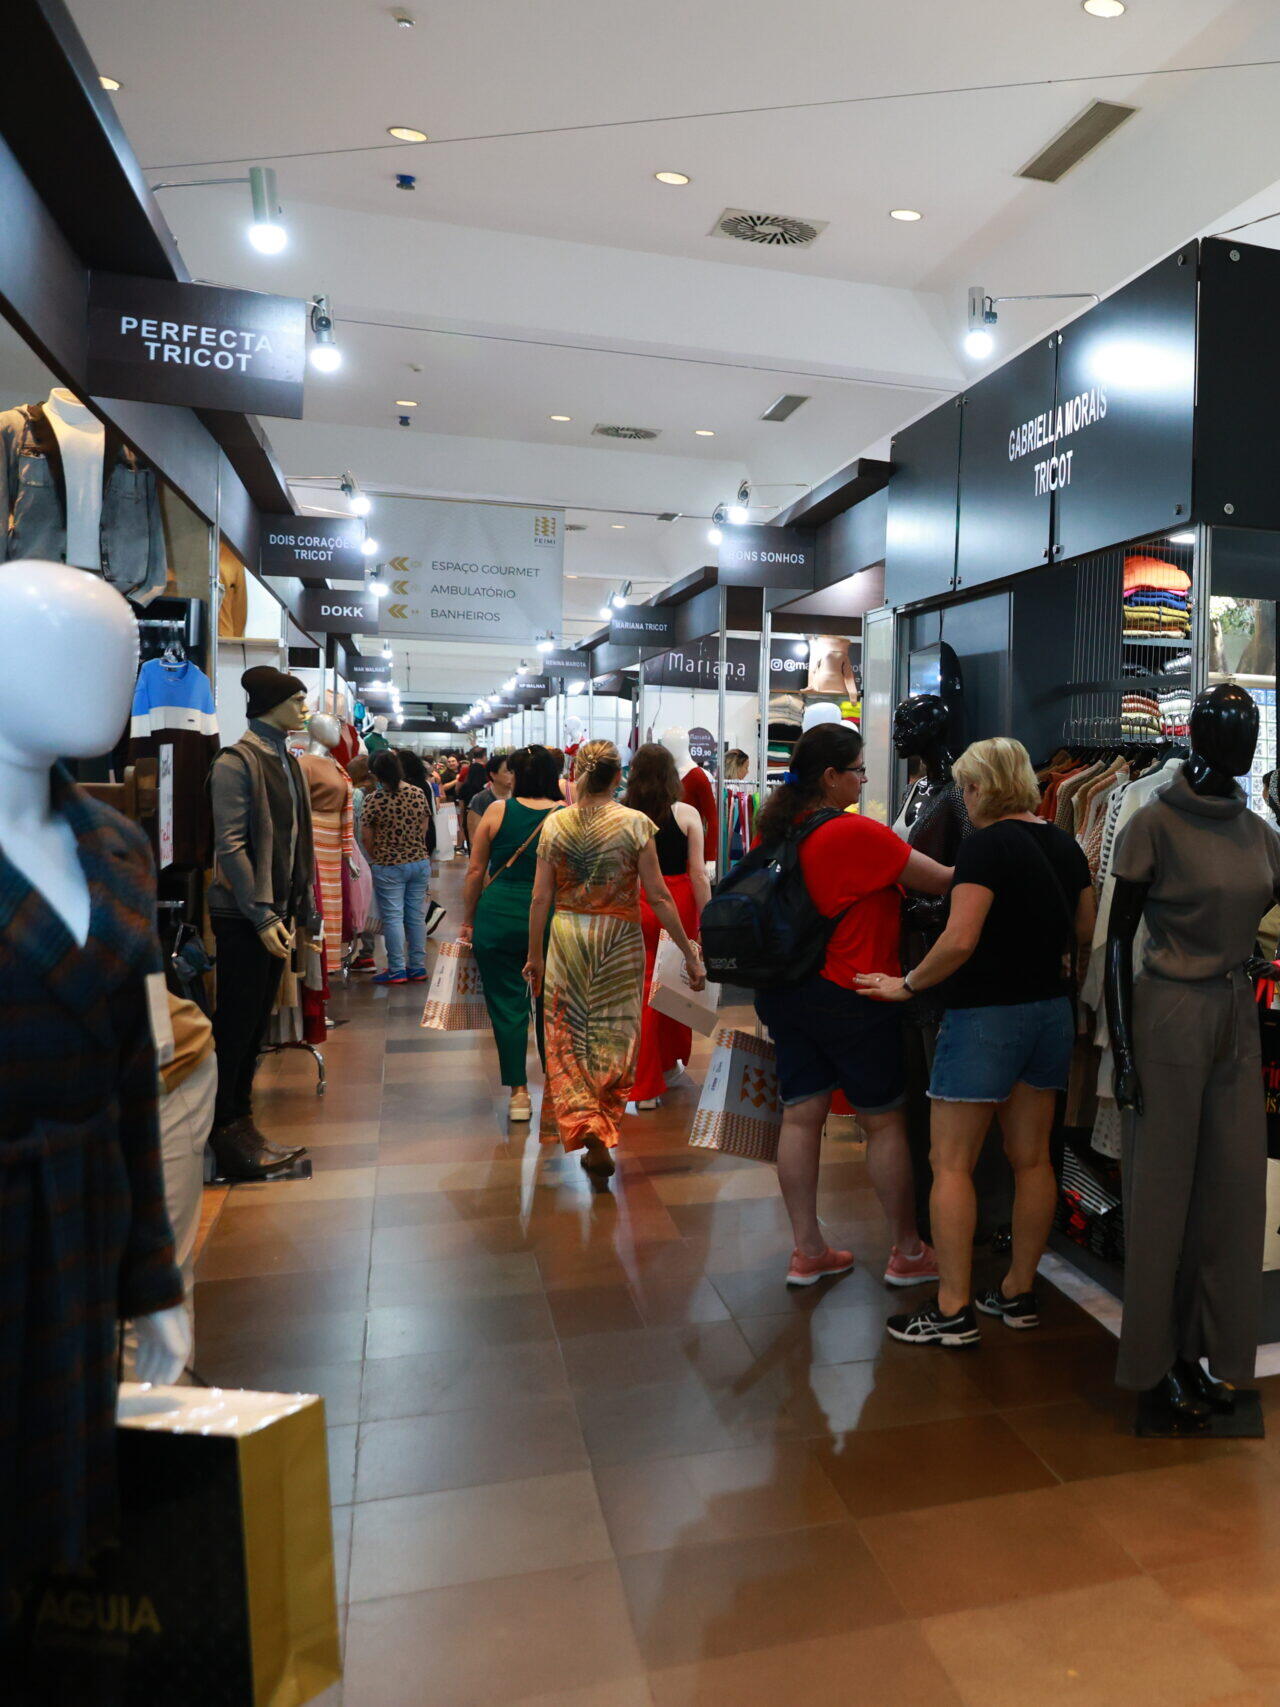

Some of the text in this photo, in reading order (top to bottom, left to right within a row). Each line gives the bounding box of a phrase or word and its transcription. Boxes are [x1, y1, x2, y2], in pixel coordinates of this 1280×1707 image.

[120, 315, 274, 354] PERFECTA
[143, 341, 253, 373] TRICOT
[1008, 384, 1108, 462] GABRIELLA MORAIS
[1034, 449, 1074, 497] TRICOT
[269, 534, 296, 546] DOIS
[294, 549, 333, 561] TRICOT
[760, 551, 805, 564] SONHOS
[431, 561, 540, 578] ESPAÇO GOURMET
[430, 584, 516, 599] AMBULATÓRIO
[321, 605, 364, 618] DOKK
[430, 608, 501, 622] BANHEIROS
[614, 620, 668, 632] MARIANA TRICOT
